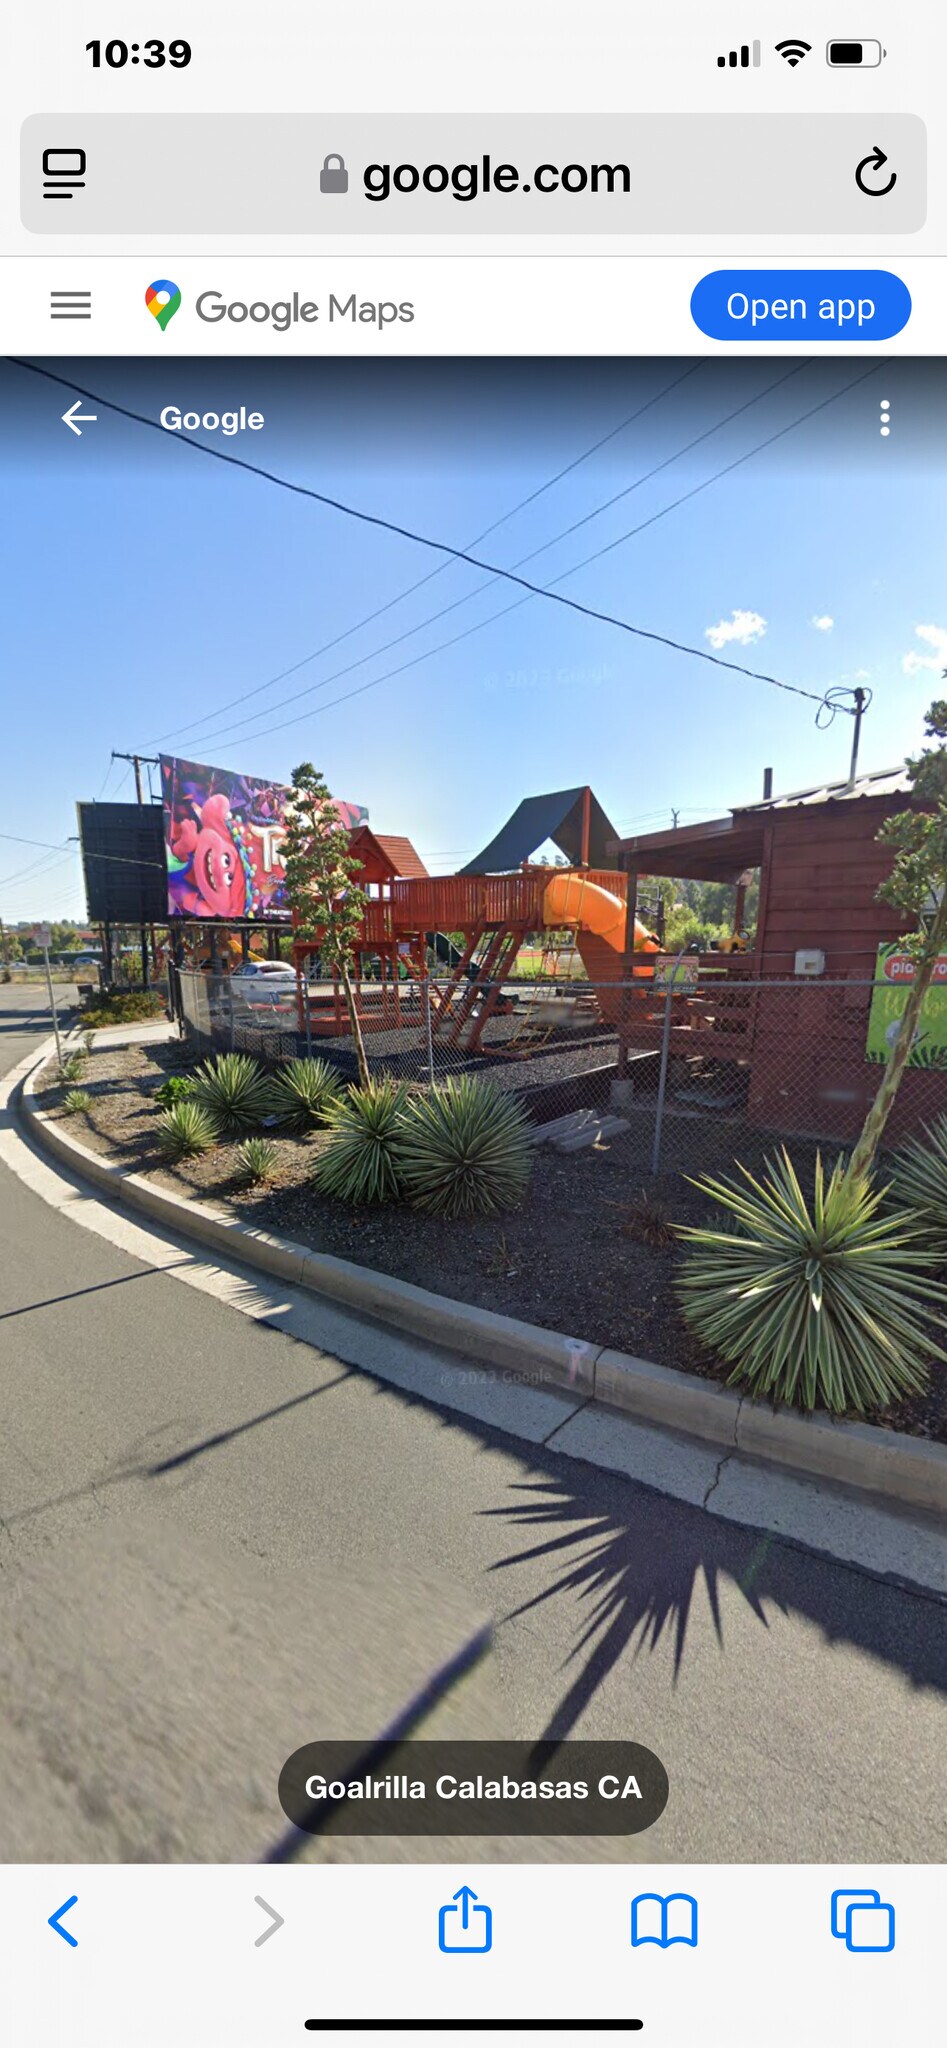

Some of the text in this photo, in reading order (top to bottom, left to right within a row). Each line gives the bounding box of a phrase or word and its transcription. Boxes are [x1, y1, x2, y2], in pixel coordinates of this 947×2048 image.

[85, 39, 192, 69] 10:39
[363, 155, 631, 202] google.com
[195, 290, 415, 332] Google Maps
[726, 292, 876, 327] Open app
